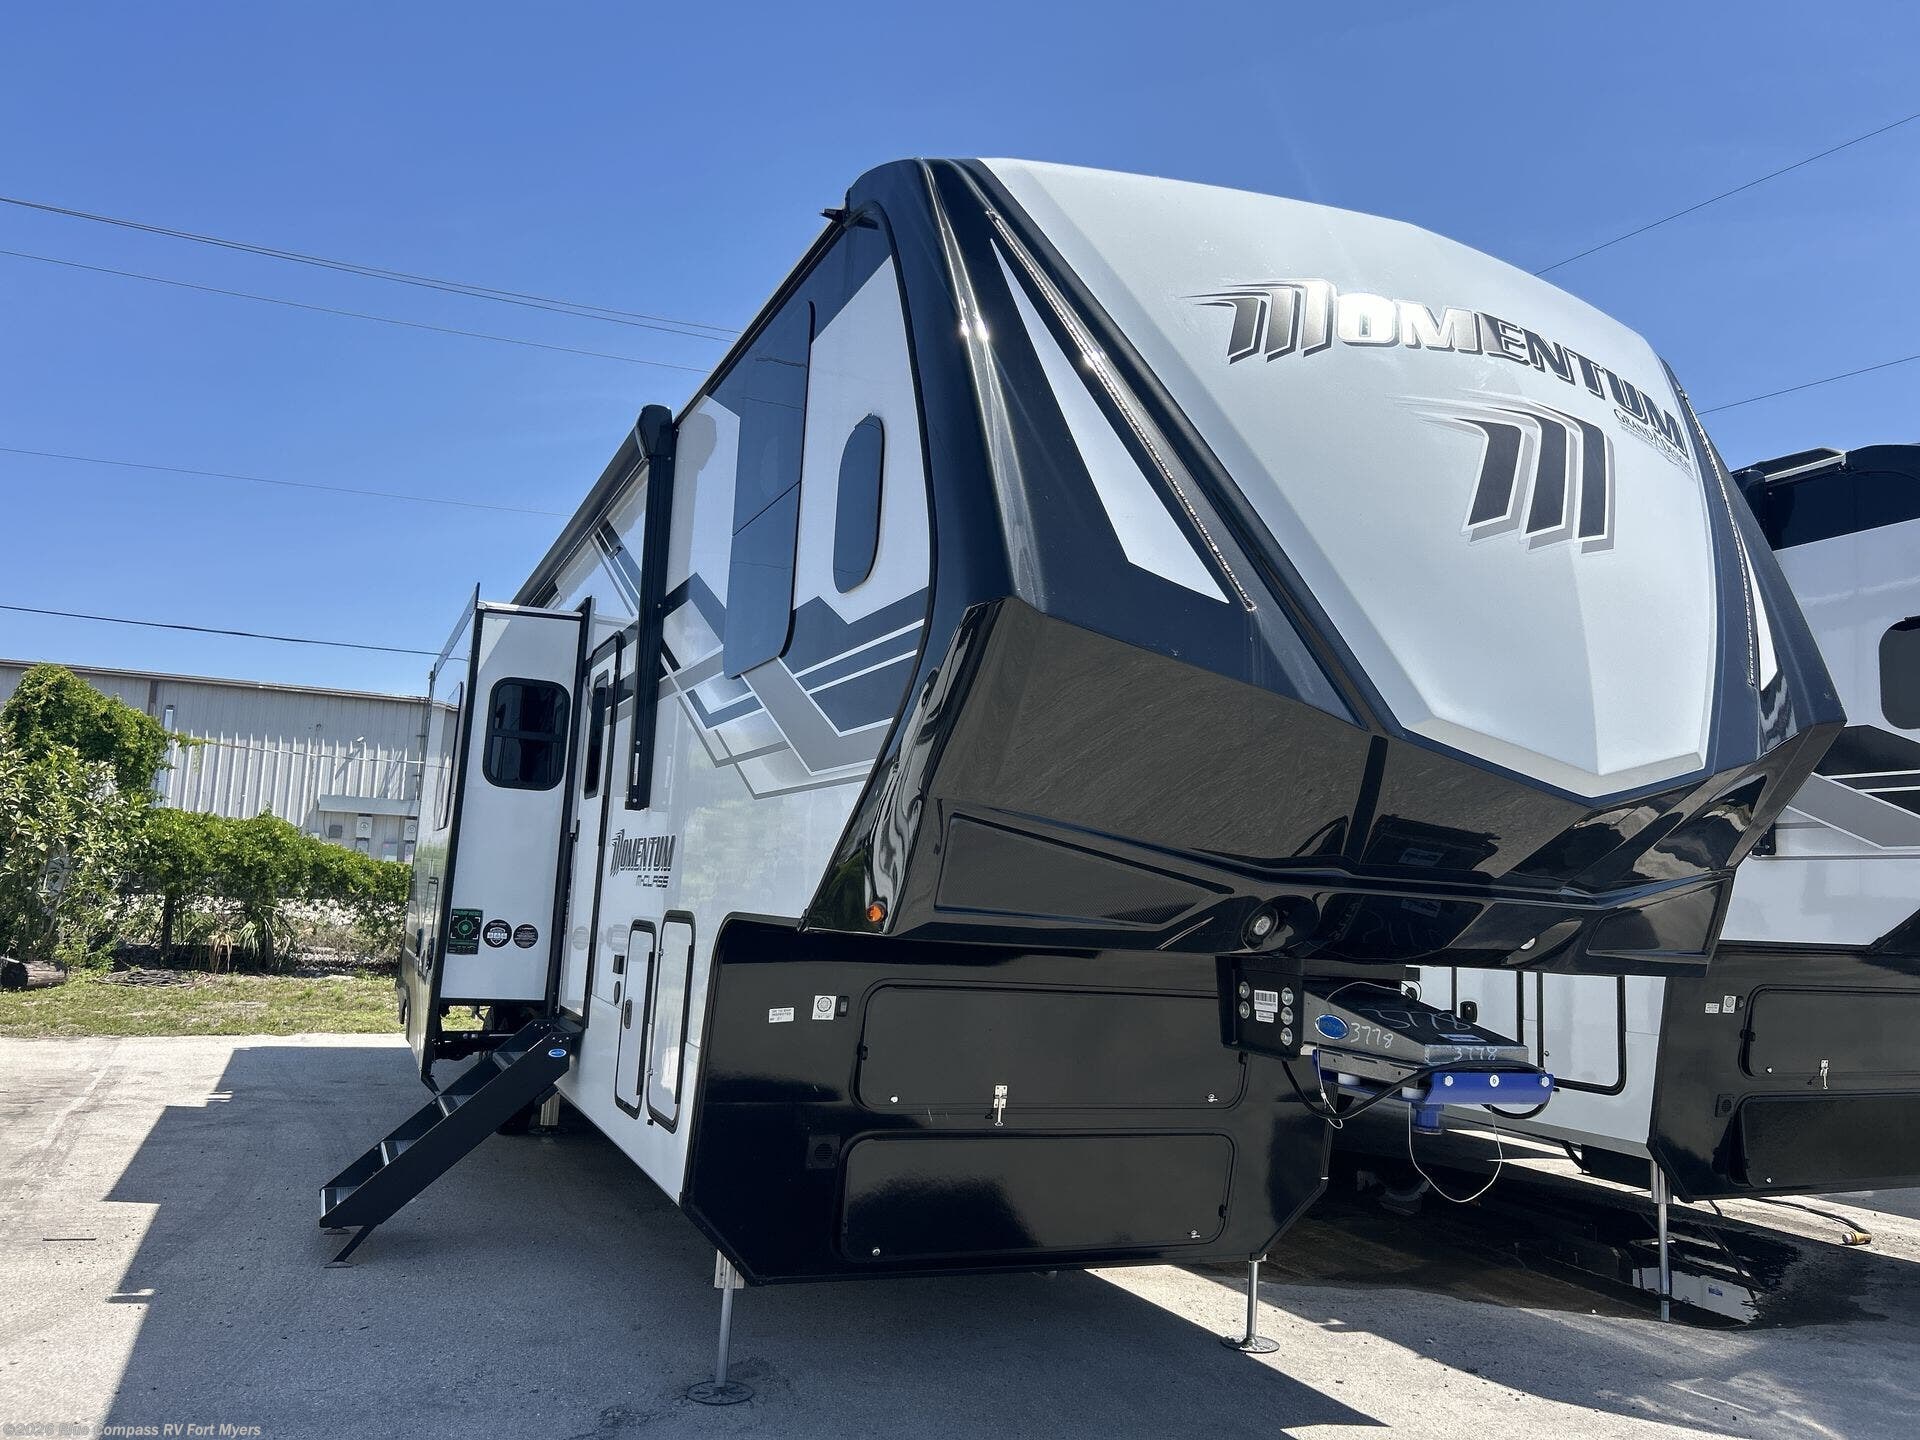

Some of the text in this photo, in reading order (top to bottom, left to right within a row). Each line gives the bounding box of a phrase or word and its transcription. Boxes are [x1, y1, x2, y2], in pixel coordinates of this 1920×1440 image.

[1184, 278, 1689, 461] MOMENTUM
[610, 829, 676, 876] MOMENTUM
[1350, 1022, 1395, 1048] 3778
[1453, 1046, 1498, 1062] 3778
